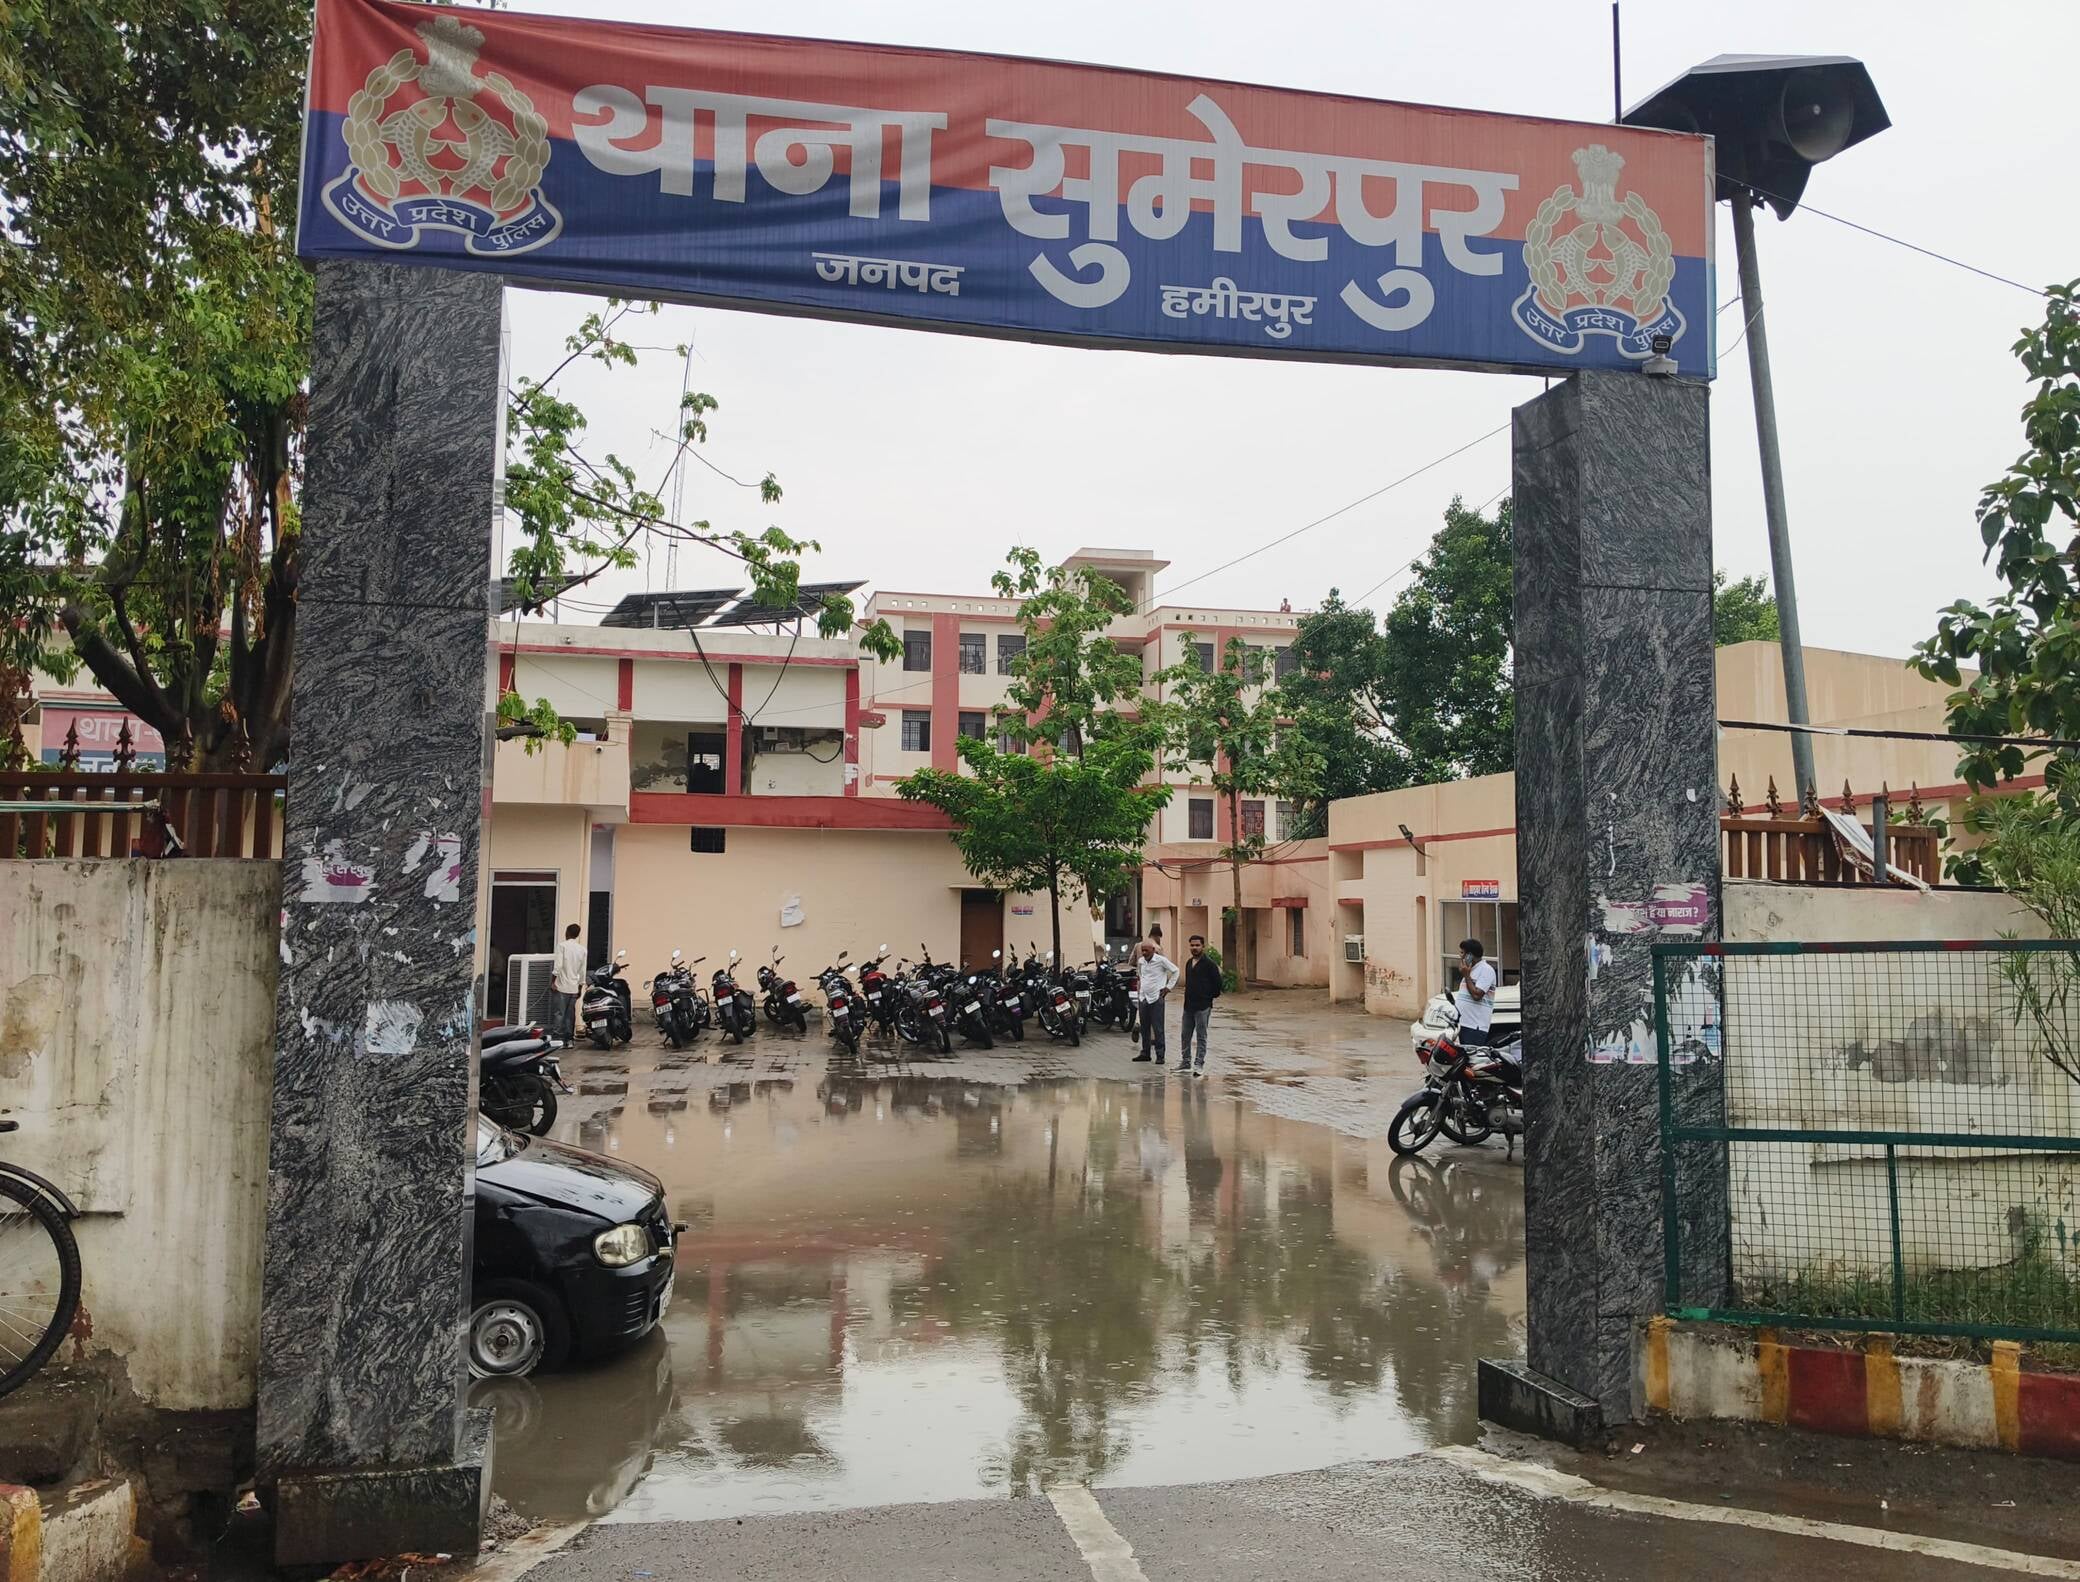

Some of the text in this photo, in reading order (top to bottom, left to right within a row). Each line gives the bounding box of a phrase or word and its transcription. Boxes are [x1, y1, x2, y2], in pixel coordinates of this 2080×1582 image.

[342, 193, 547, 250] उत्तर प्रदेश पुलिस
[571, 84, 1520, 331] थाना सुमेरपुर
[811, 252, 1318, 339] जनपद हमीरपुर
[1526, 307, 1567, 344] उत्तर
[1574, 309, 1625, 332] प्रदेश
